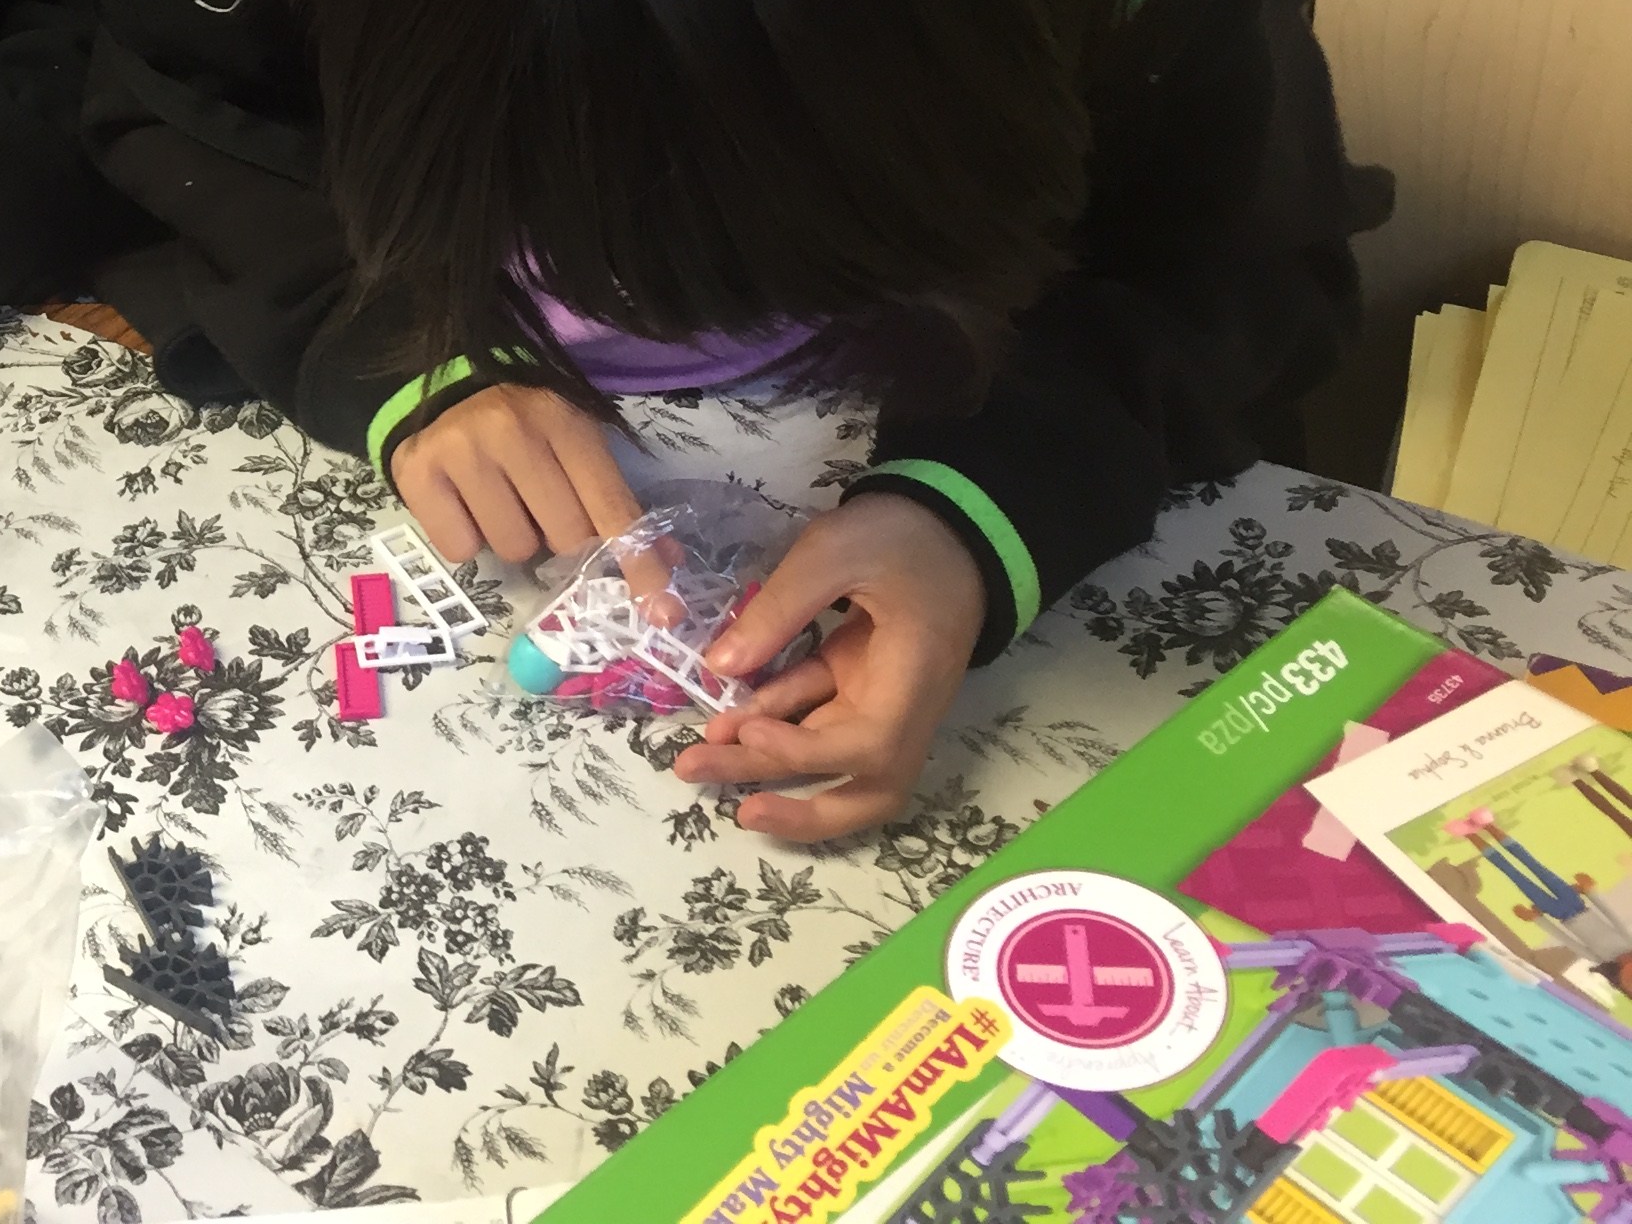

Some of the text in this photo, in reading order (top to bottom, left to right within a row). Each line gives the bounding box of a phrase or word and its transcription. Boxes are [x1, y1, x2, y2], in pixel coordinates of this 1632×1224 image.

[1405, 710, 1543, 782] Brianna & Sophia
[1163, 921, 1199, 977] Learn
[881, 1061, 896, 1074] a
[892, 1007, 953, 1066] Become
[762, 1006, 1001, 1224] #IAmAMighty
[768, 1070, 878, 1171] Mighty
